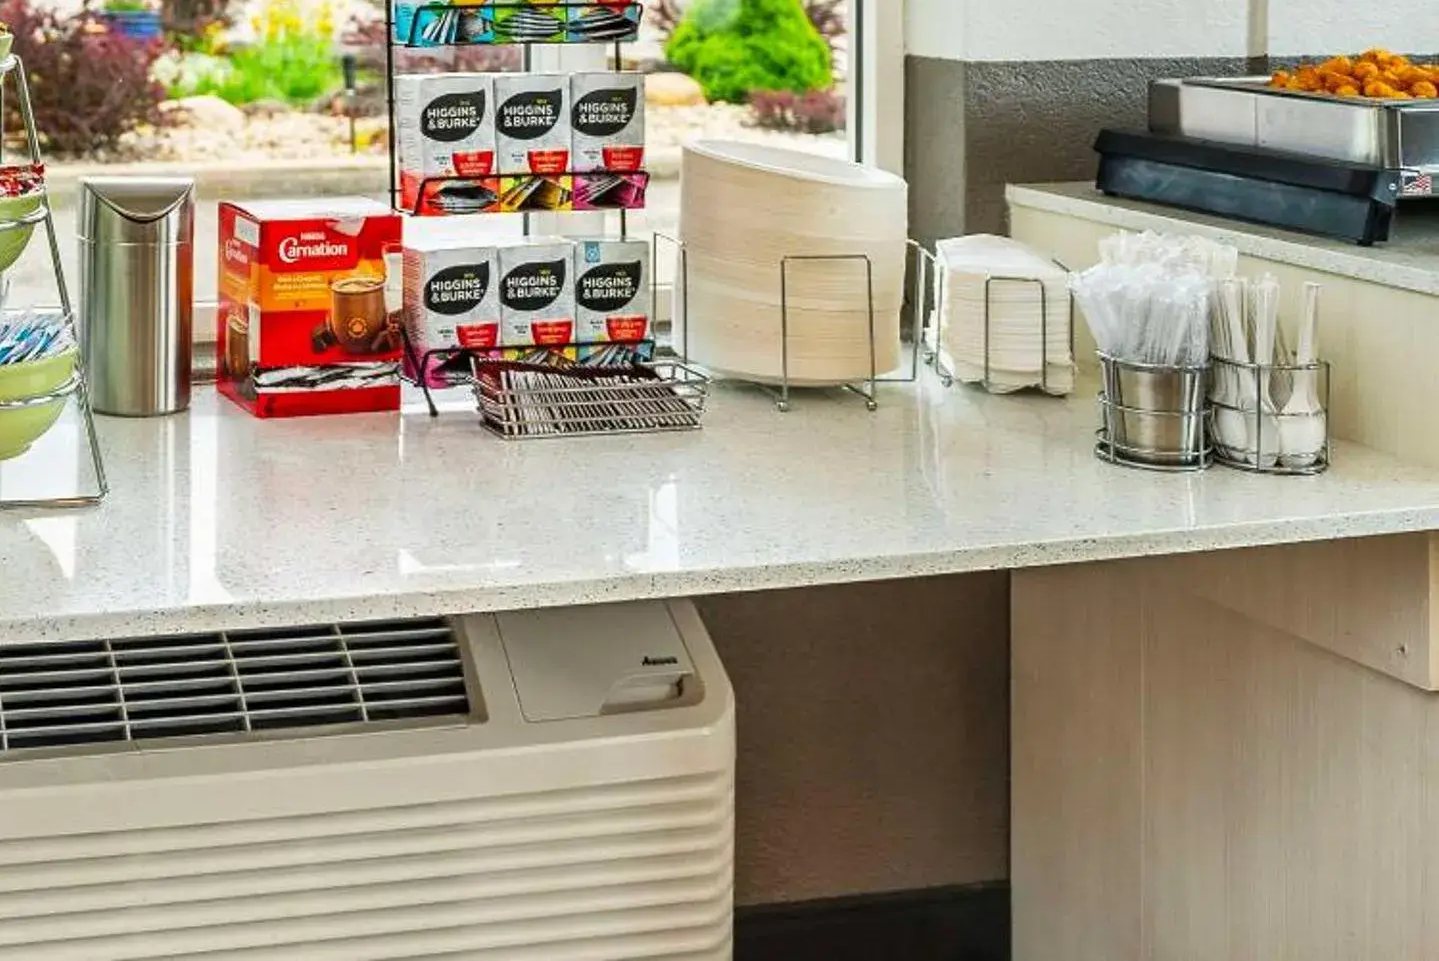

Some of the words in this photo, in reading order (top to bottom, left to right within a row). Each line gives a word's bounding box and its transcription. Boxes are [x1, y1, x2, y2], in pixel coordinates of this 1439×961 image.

[427, 106, 477, 119] HIGGINS
[504, 105, 553, 116] HIGGINS
[579, 102, 628, 113] HIGGINS
[279, 237, 348, 263] Carnation
[431, 278, 481, 292] HIGGINS
[507, 276, 557, 288] HIGGINS
[583, 277, 632, 288] HIGGINS
